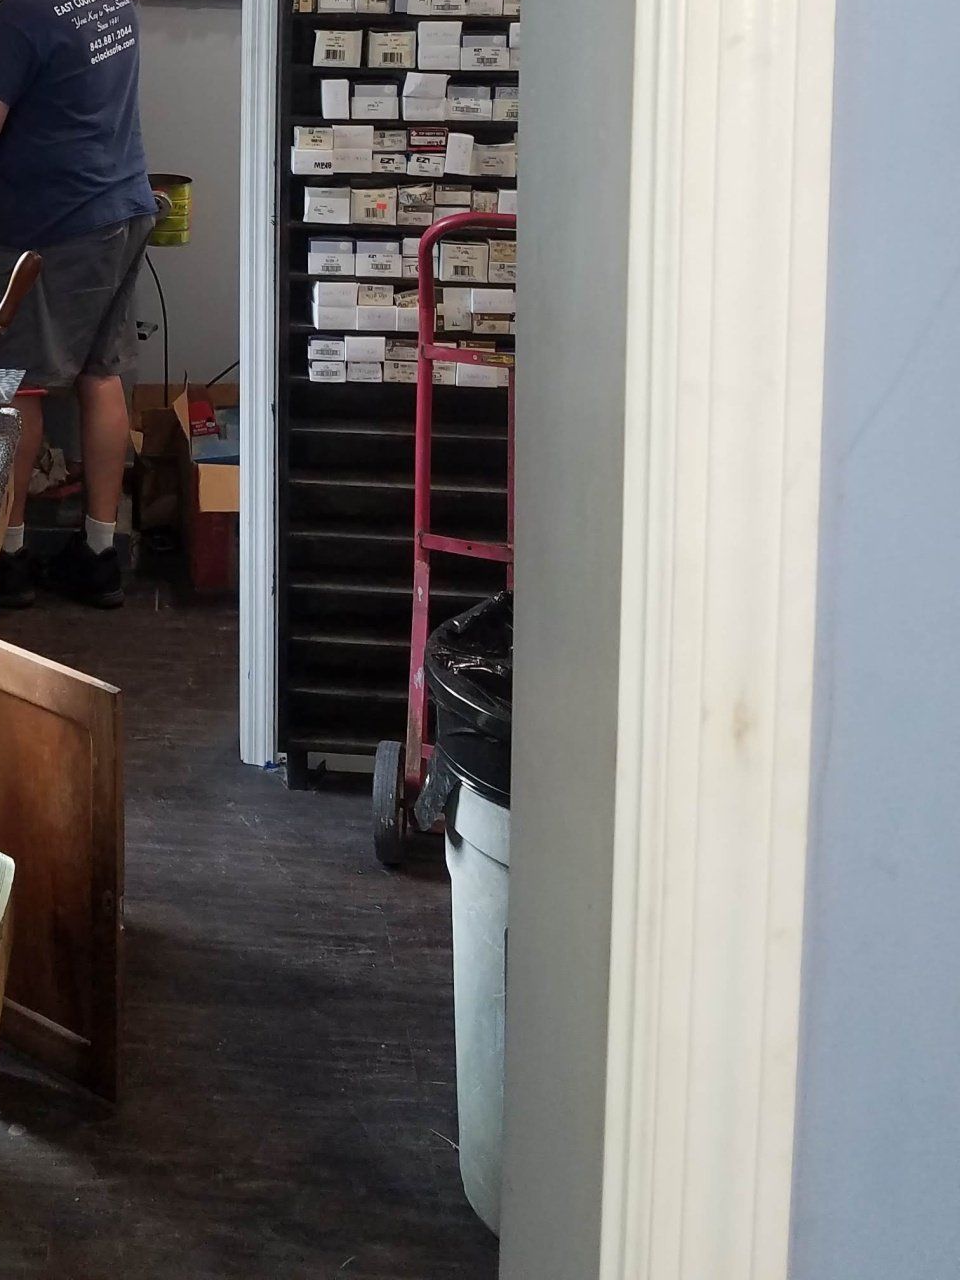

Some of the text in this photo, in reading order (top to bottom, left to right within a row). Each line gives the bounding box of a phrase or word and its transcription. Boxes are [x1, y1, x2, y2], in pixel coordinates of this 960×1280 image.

[53, 1, 75, 16] EAST
[88, 10, 99, 22] Key
[97, 21, 109, 32] Since
[90, 24, 133, 52] 843.881.2044
[90, 37, 136, 65] eclocksafe.com
